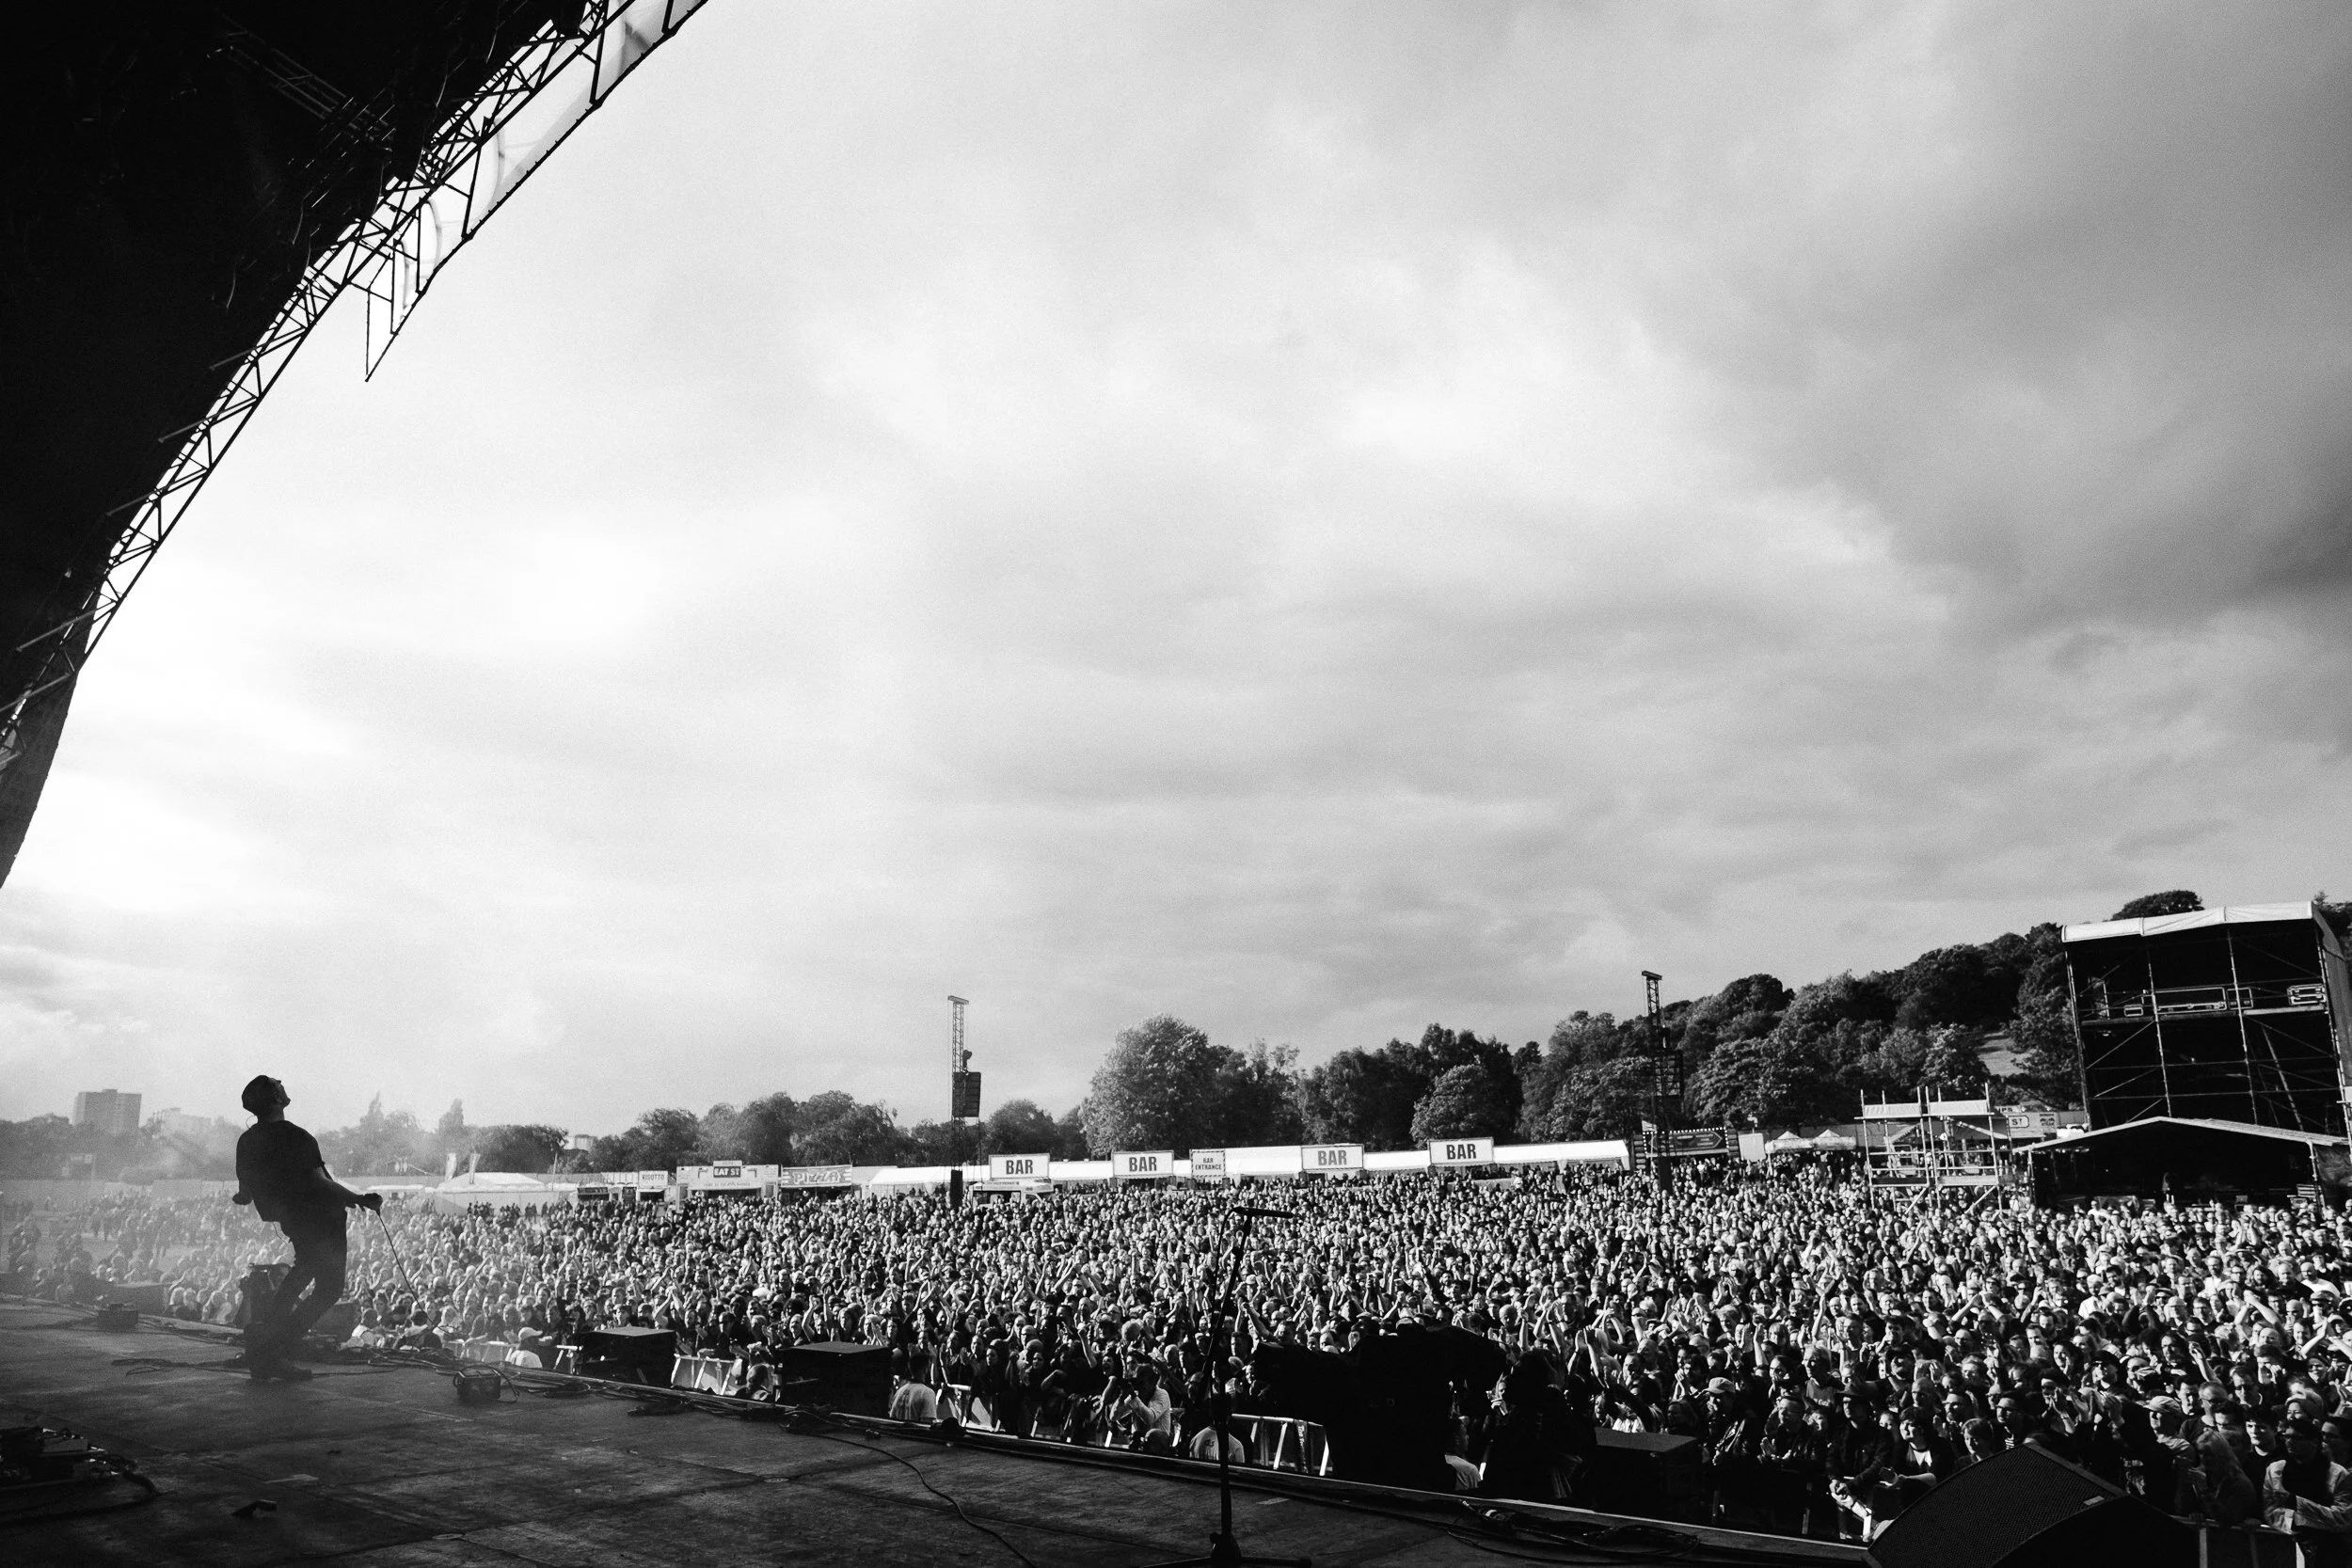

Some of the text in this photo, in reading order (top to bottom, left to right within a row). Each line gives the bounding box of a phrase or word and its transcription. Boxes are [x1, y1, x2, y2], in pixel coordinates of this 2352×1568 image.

[1317, 1149, 1347, 1165] BAR
[1446, 1144, 1476, 1160] BAR
[730, 1167, 740, 1176] ST
[1006, 1159, 1033, 1175] BAR
[1129, 1156, 1157, 1172] BAR
[792, 1169, 841, 1184] PIZZA
